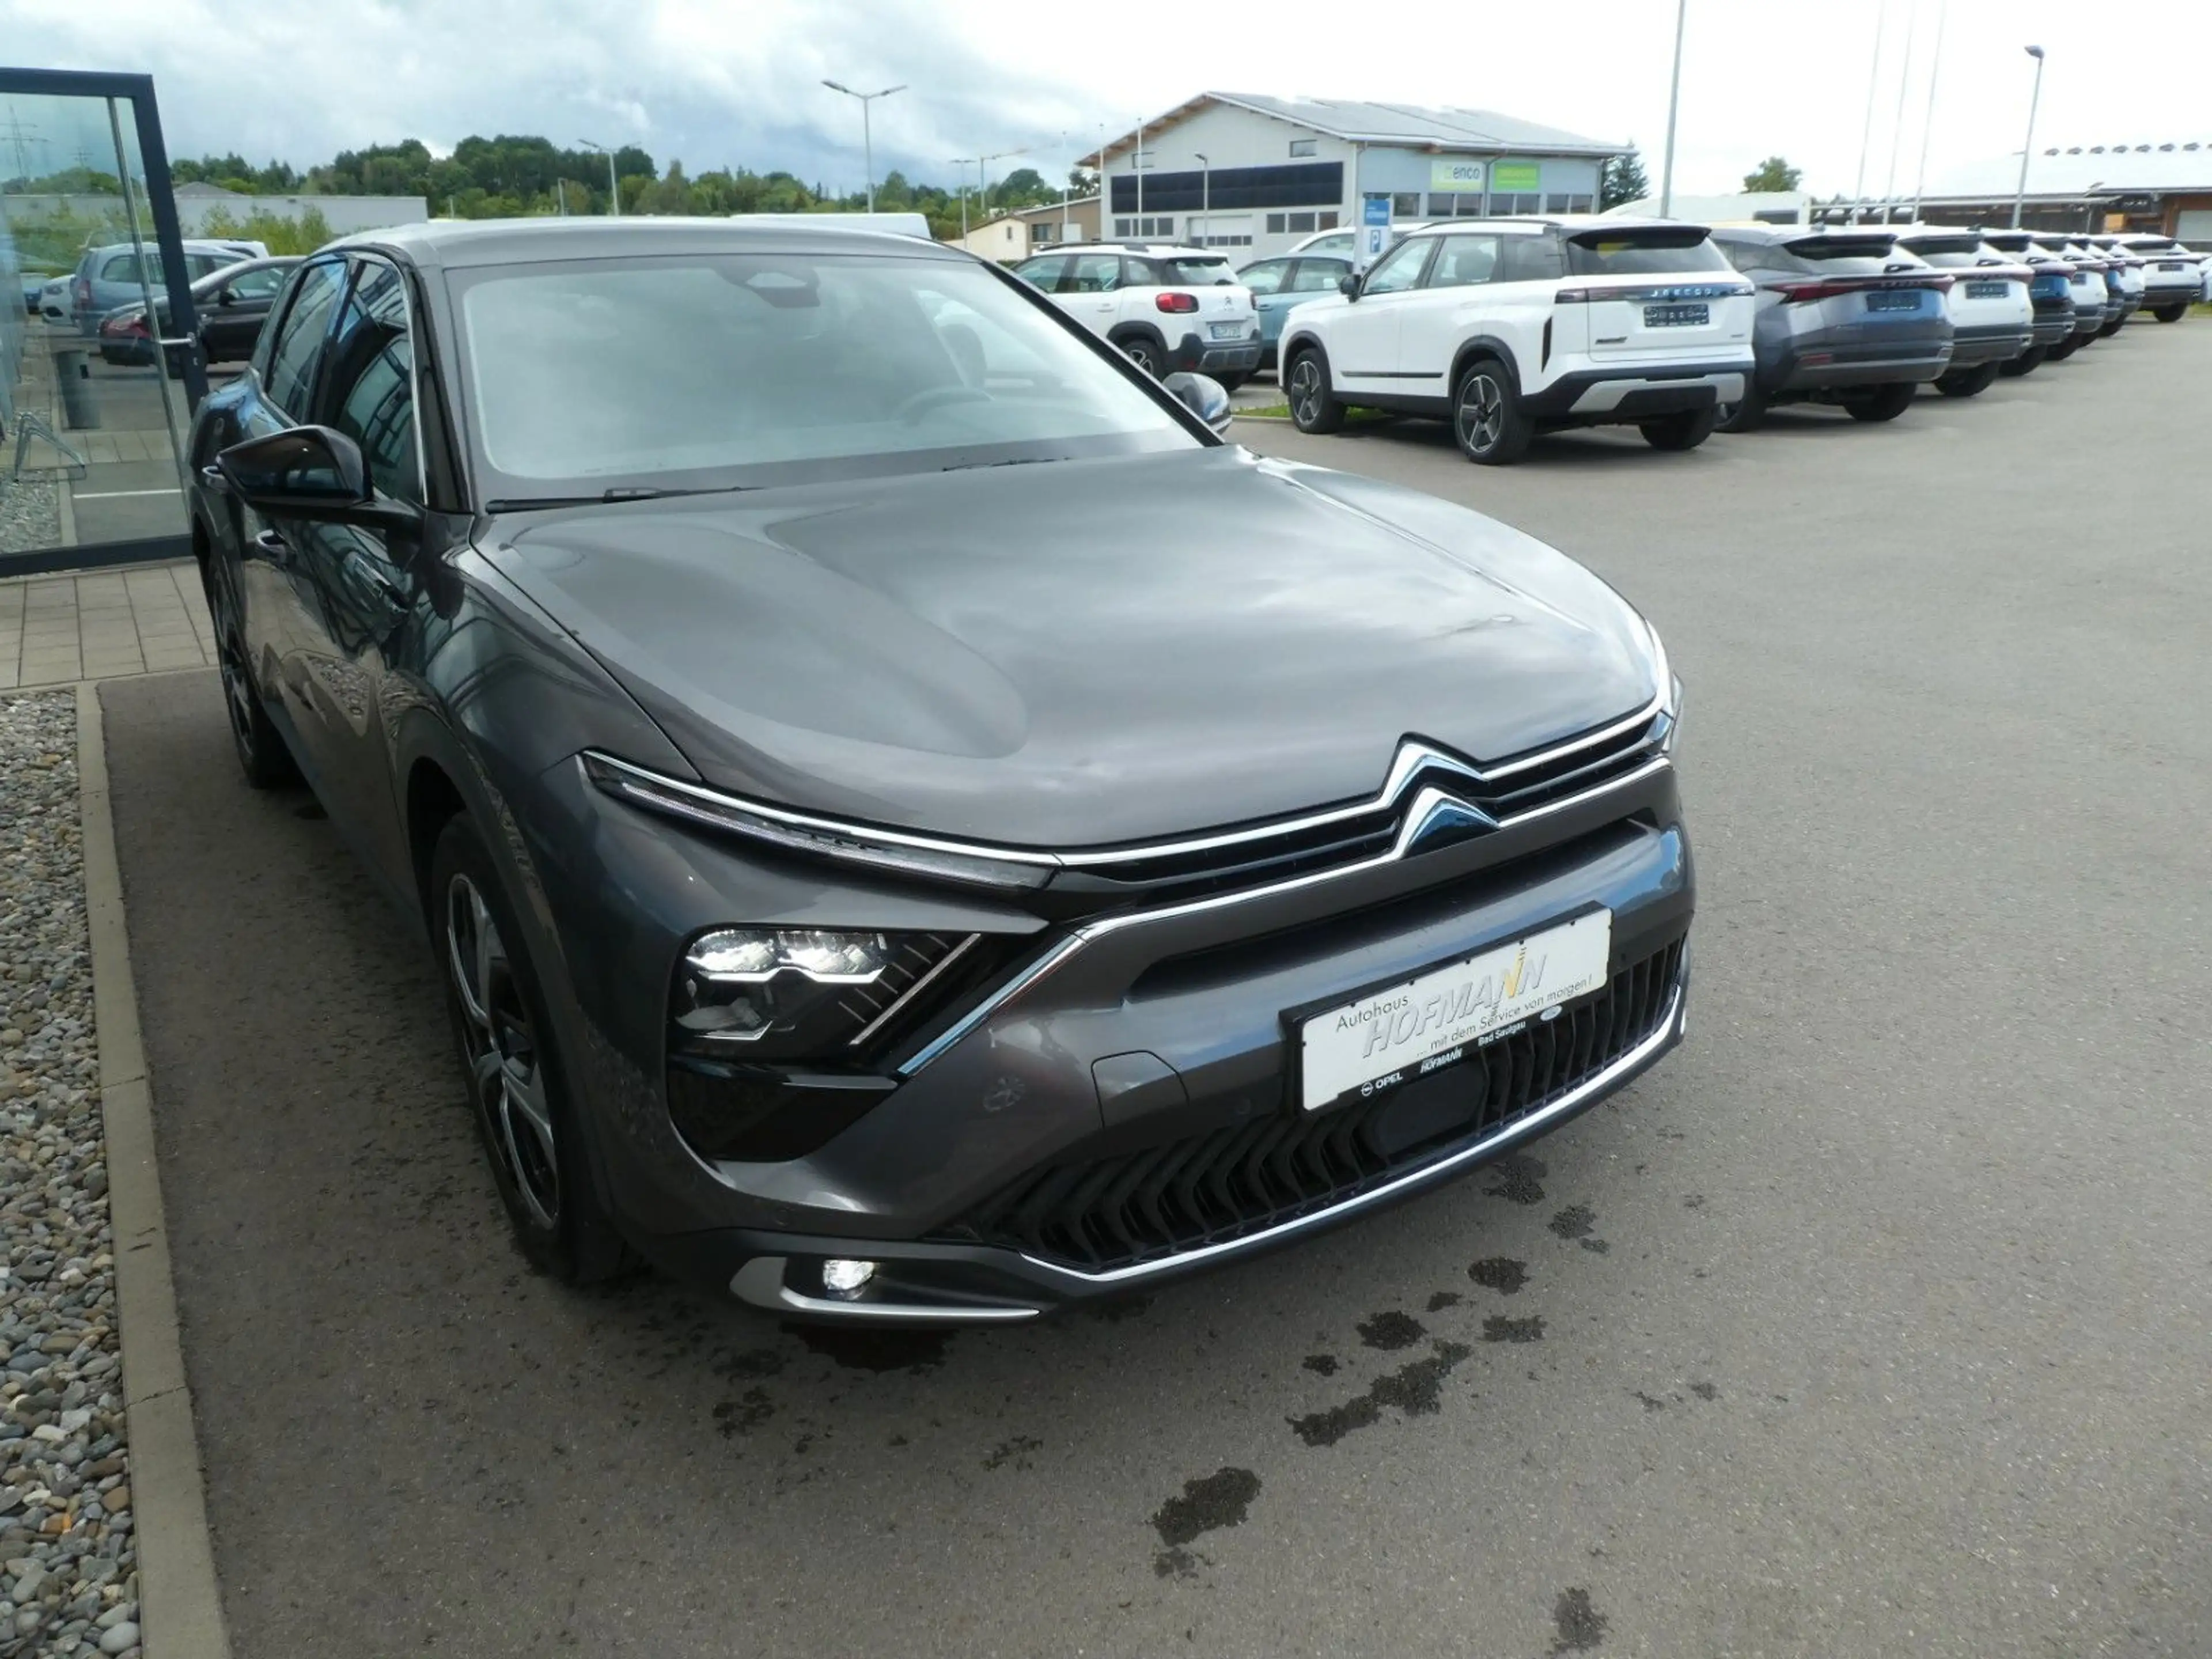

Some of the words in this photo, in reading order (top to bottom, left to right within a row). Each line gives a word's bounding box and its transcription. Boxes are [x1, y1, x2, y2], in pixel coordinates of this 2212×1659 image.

[1336, 995, 1409, 1032] Autohaus
[1362, 947, 1548, 1059] HOFMANN
[1451, 1024, 1476, 1041] dem
[1479, 1006, 1521, 1029] Service
[1524, 997, 1544, 1011] von
[1375, 1071, 1404, 1089] OPEL
